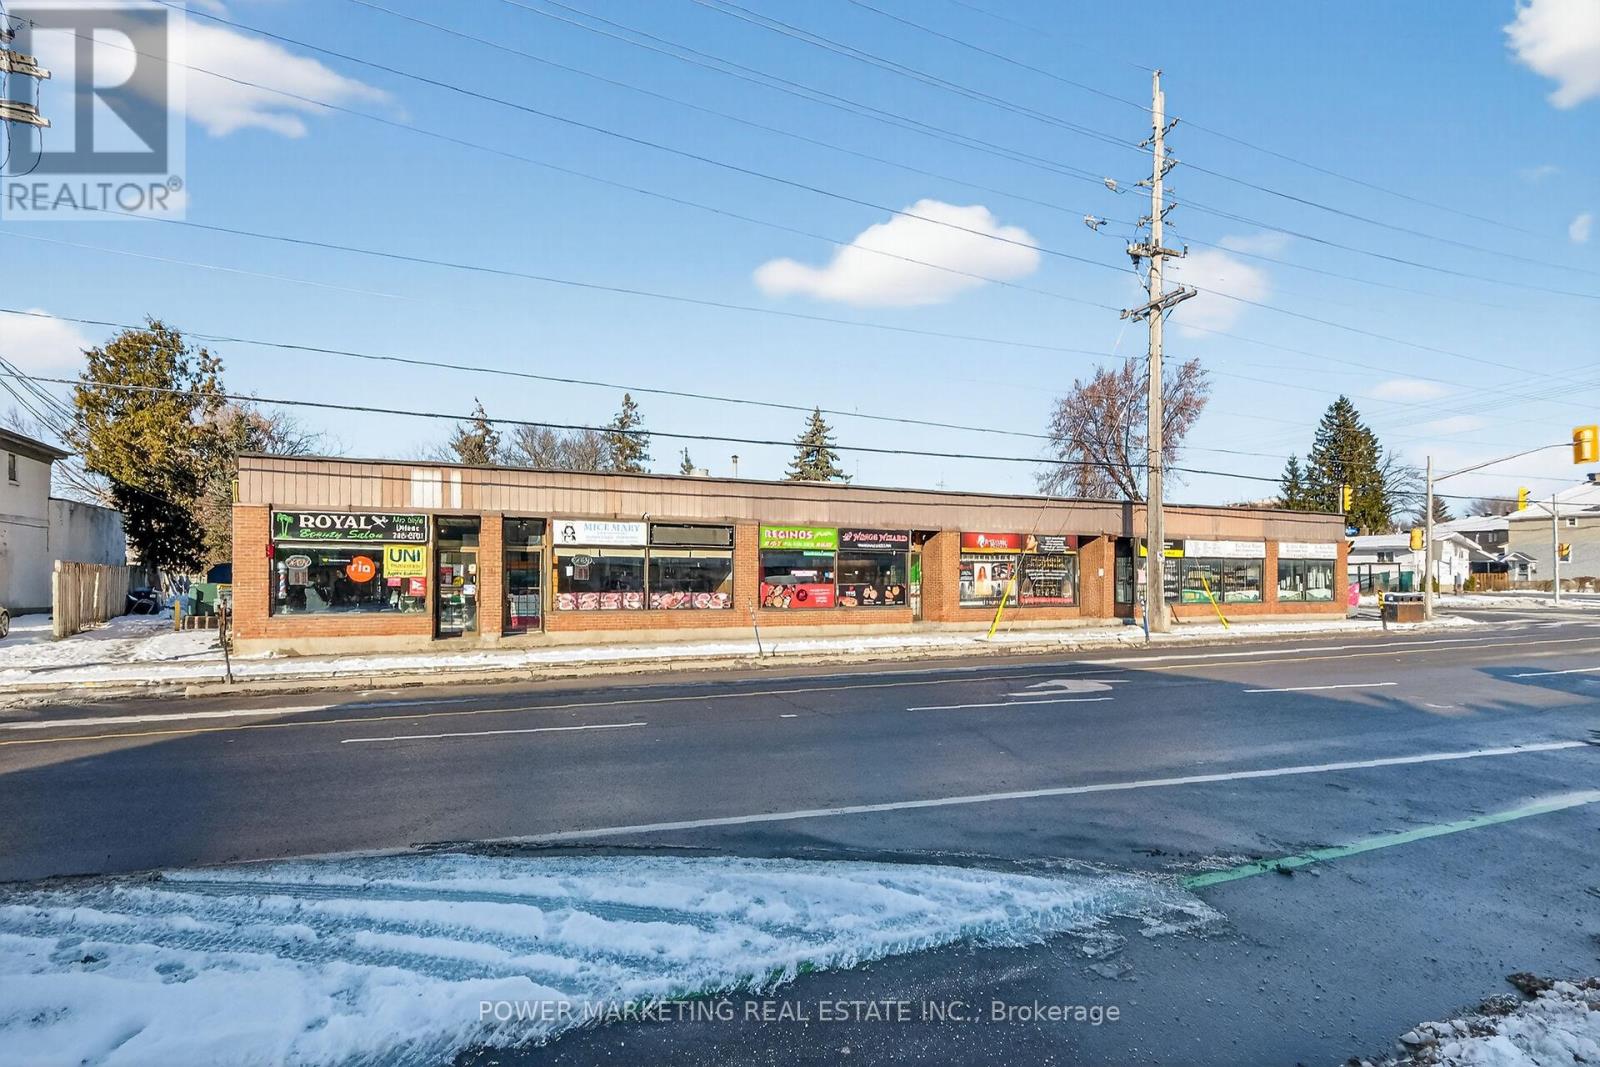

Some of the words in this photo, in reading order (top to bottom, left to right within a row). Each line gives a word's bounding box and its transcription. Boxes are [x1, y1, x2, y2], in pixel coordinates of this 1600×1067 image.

[299, 514, 373, 530] ROYAL
[347, 529, 384, 539] Salon
[390, 548, 421, 562] UNI
